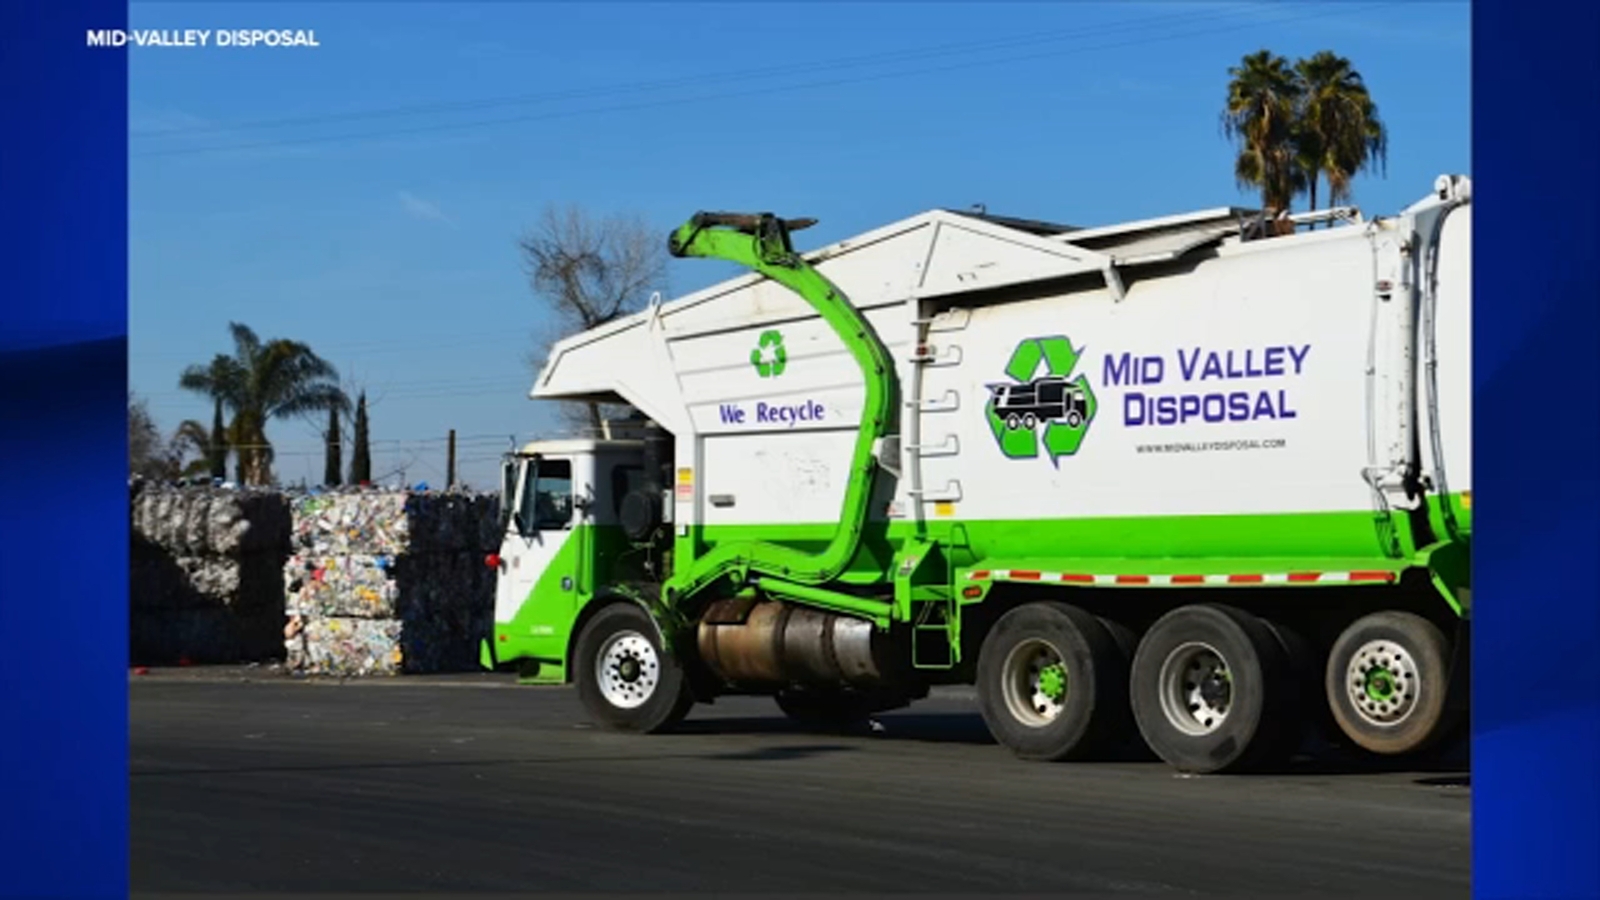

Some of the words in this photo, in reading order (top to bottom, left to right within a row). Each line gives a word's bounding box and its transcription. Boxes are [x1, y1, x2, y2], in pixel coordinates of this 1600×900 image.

[1102, 352, 1164, 387] MID
[1178, 344, 1311, 381] VALLEY
[719, 404, 745, 423] We
[756, 400, 825, 427] Recycle
[1123, 390, 1297, 427] DISPOSAL
